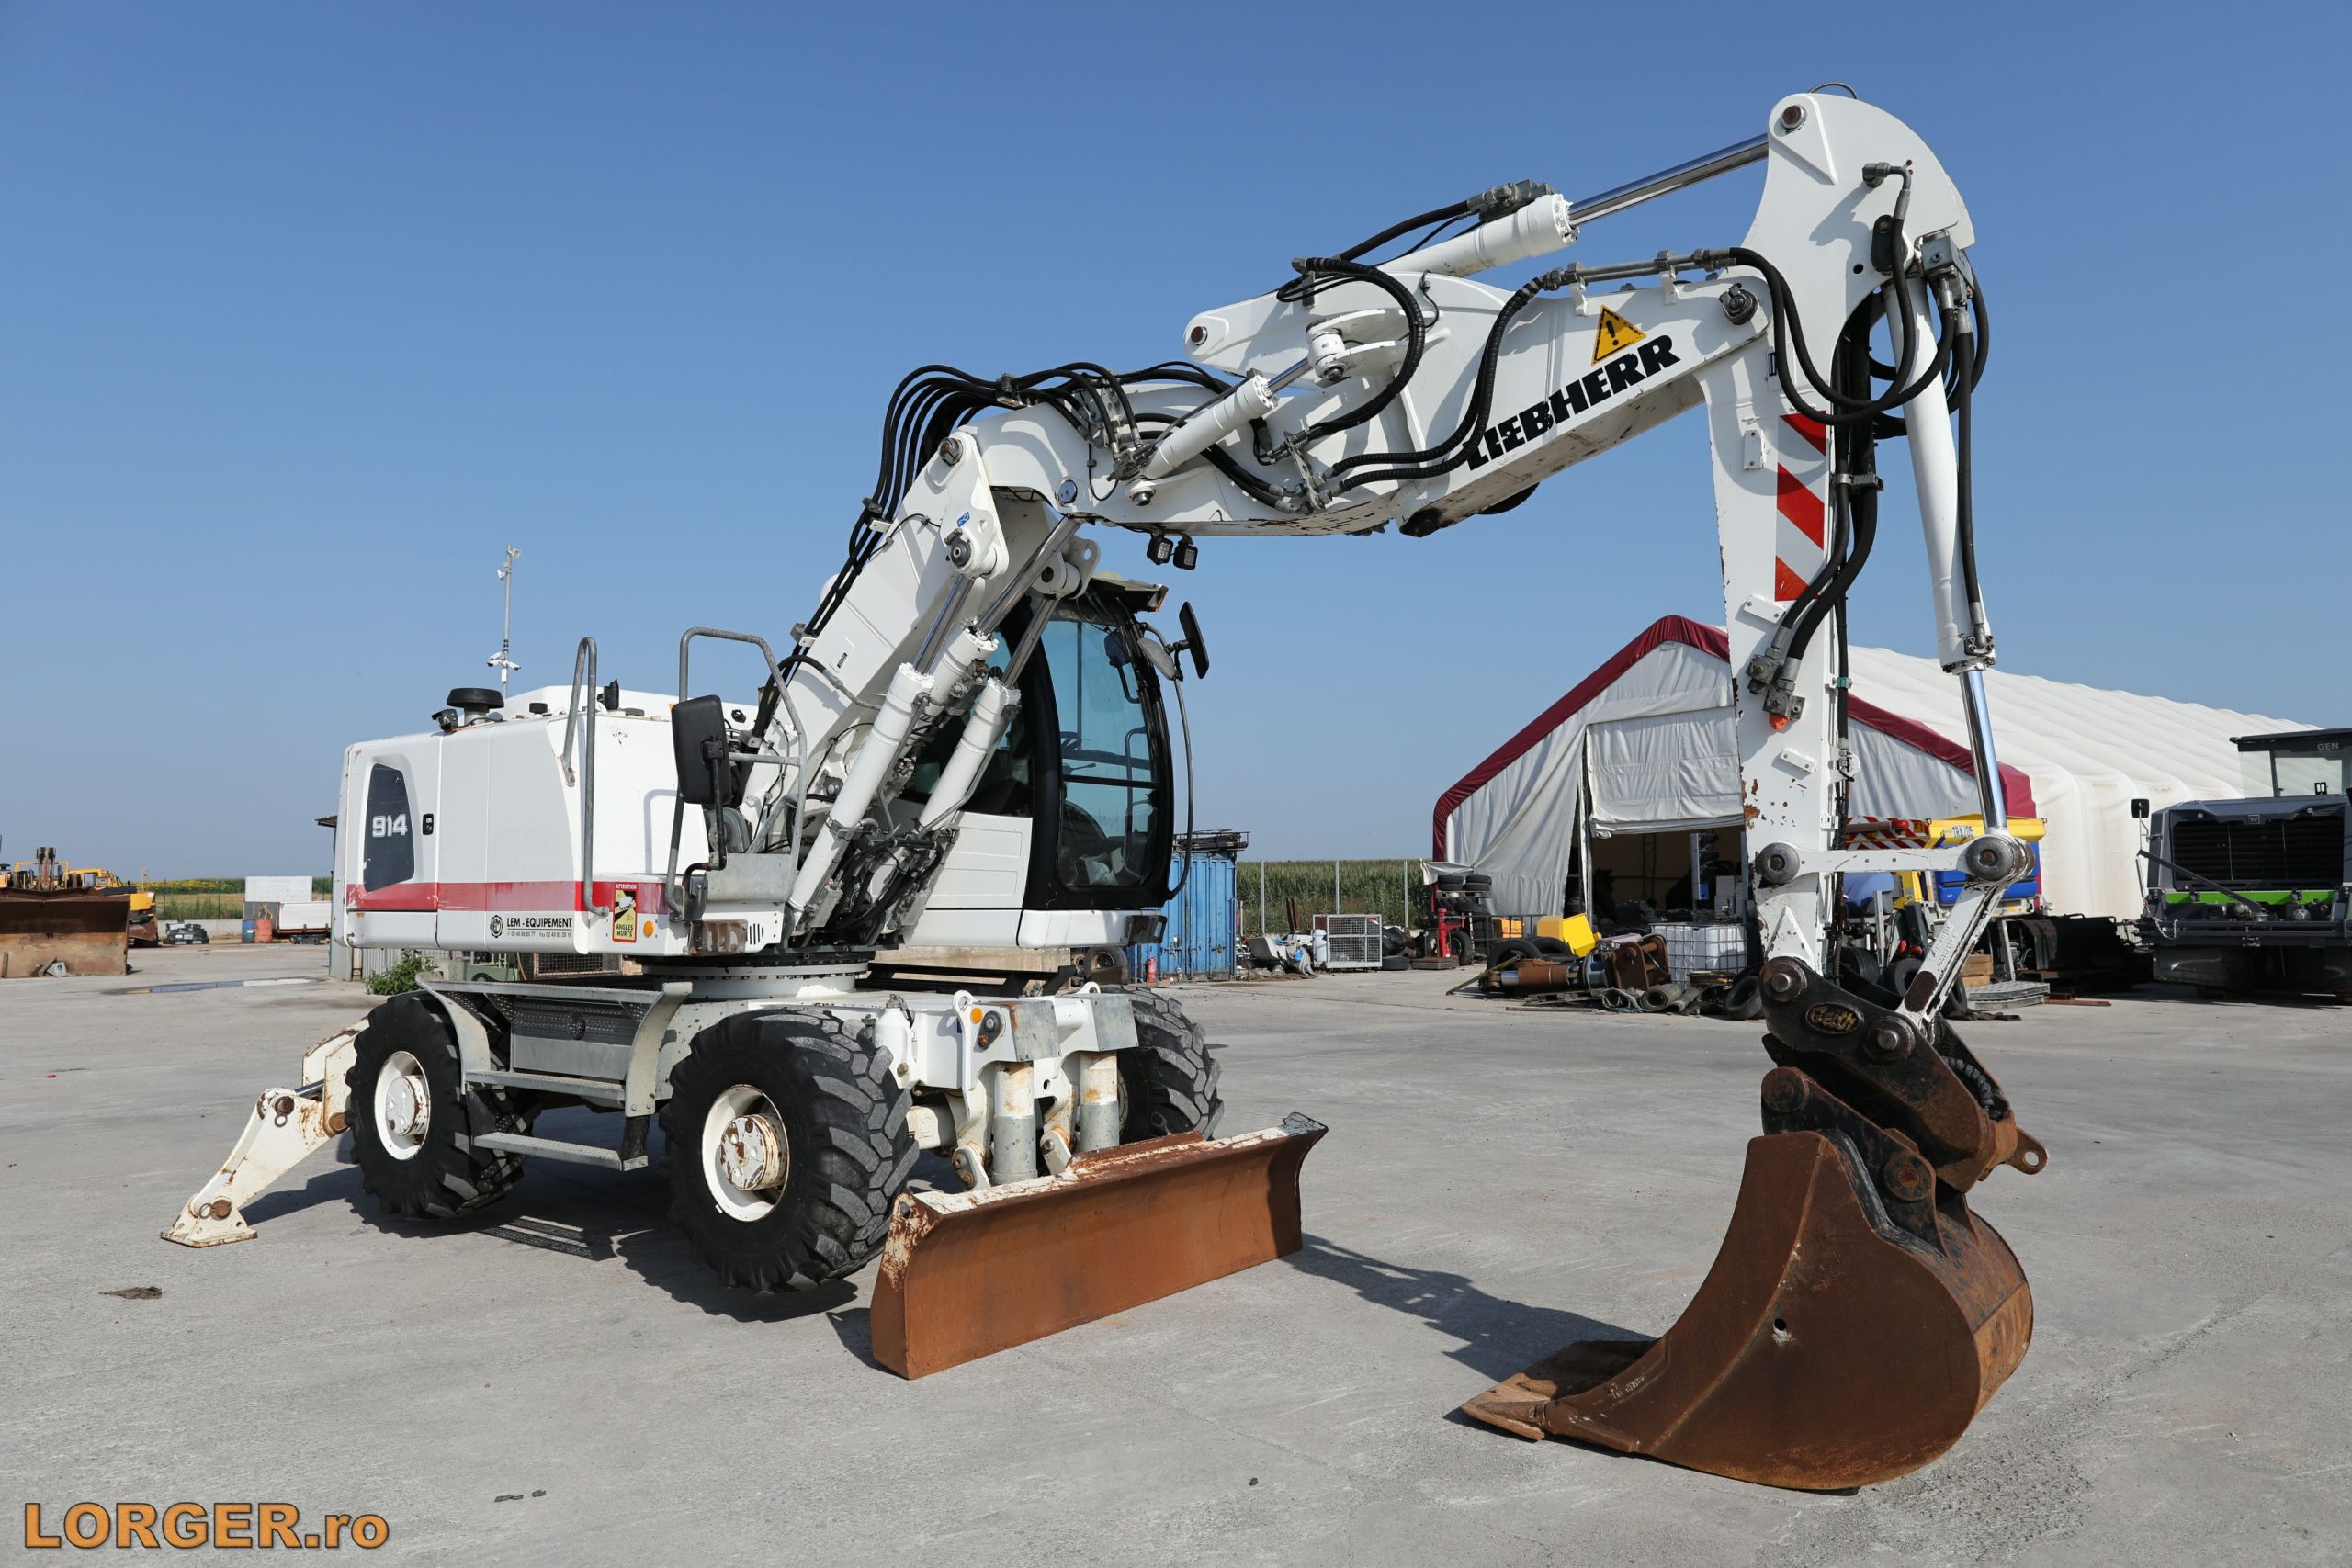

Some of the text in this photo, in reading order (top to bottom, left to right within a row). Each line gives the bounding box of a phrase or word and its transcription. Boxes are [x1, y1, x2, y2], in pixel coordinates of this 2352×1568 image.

[1463, 334, 1681, 471] LIEBHERR
[2316, 742, 2339, 750] GEN
[371, 813, 408, 838] 914
[506, 917, 521, 928] LEM
[526, 917, 572, 928] EQUIPEMENT
